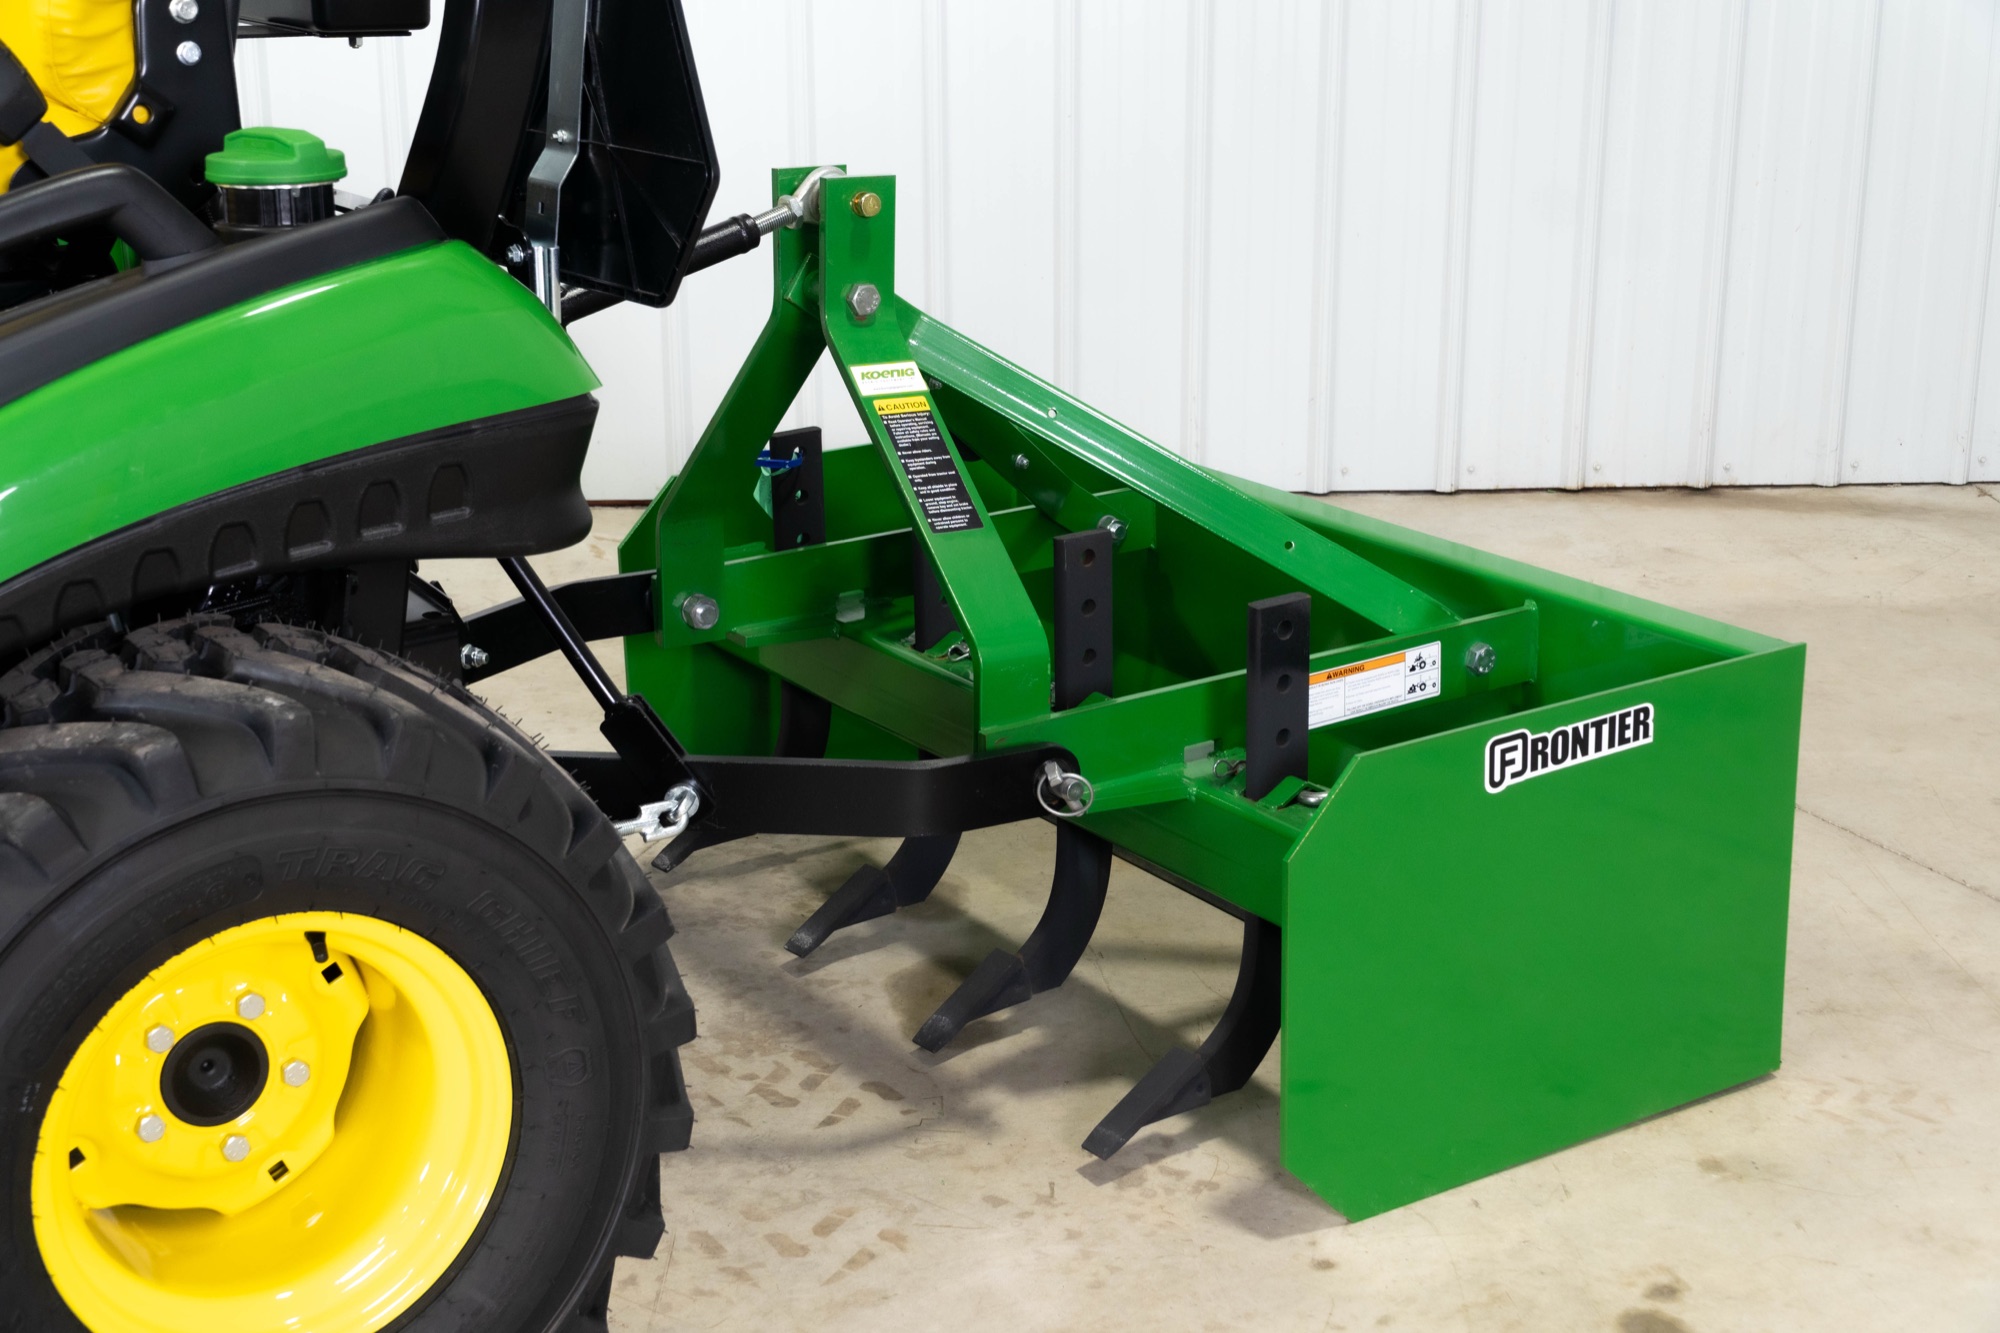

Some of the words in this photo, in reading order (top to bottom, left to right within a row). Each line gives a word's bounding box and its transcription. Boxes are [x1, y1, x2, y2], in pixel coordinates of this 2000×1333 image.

[886, 401, 926, 411] CAUTION
[1332, 664, 1365, 679] WARNING
[1489, 706, 1651, 789] FRONTIER
[277, 846, 445, 890] TRAC
[467, 890, 588, 1022] CHIEF
